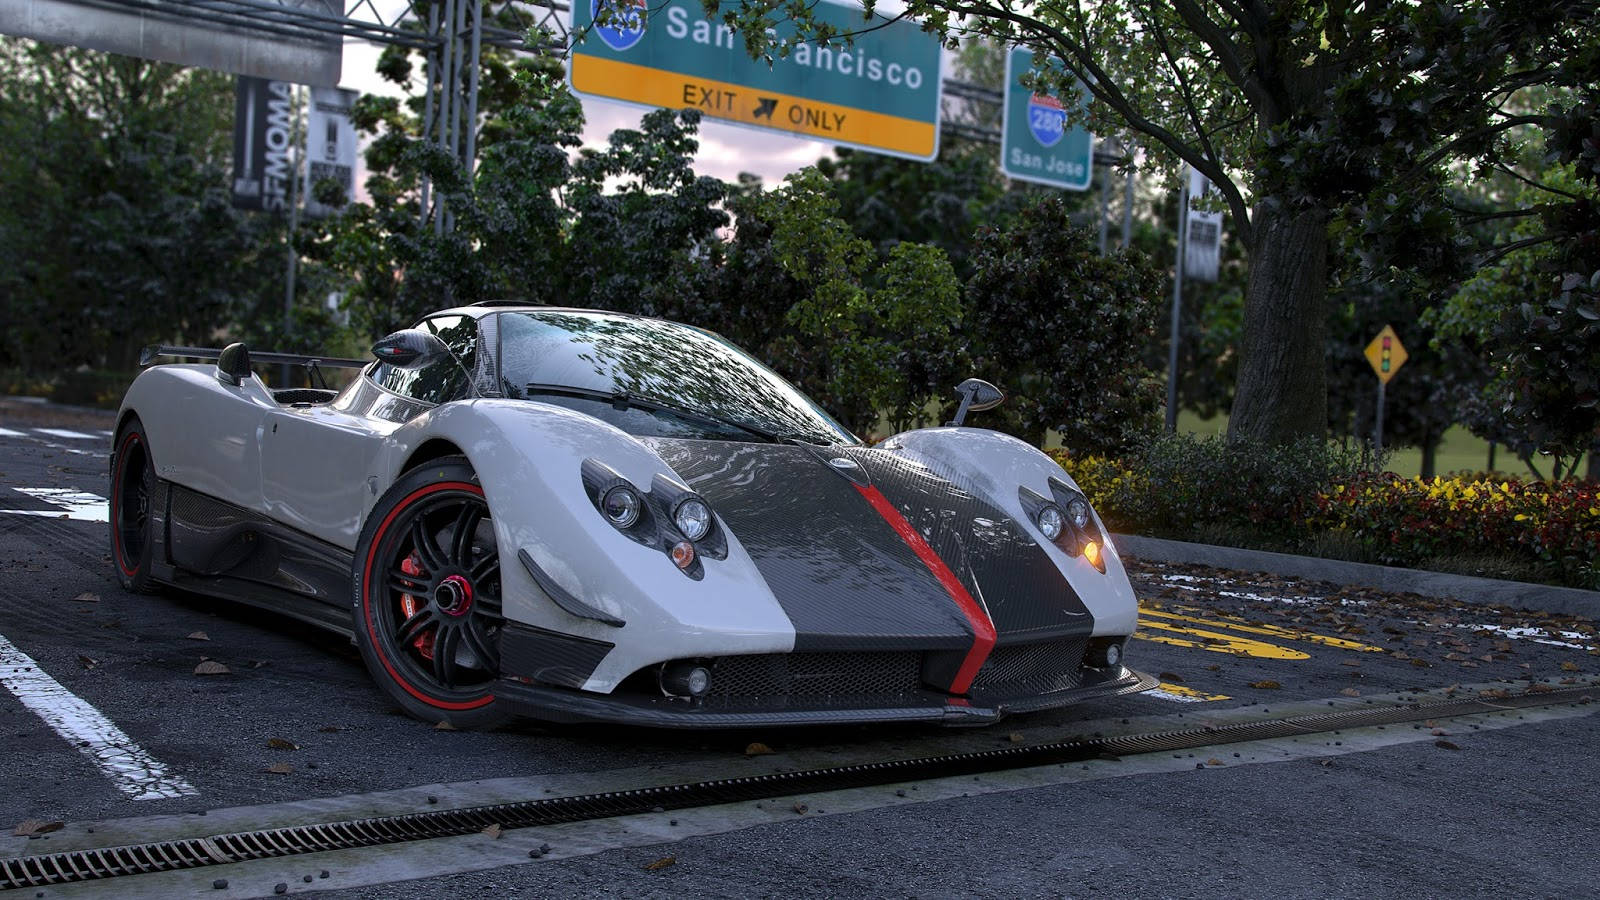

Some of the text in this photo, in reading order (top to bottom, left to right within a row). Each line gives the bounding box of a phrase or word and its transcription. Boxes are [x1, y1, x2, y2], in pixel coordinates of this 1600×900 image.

[666, 6, 735, 49] San
[683, 84, 847, 132] EXIT ONLY
[1033, 109, 1062, 132] 280
[263, 80, 290, 210] SFMOMA
[1011, 147, 1084, 177] San Jose
